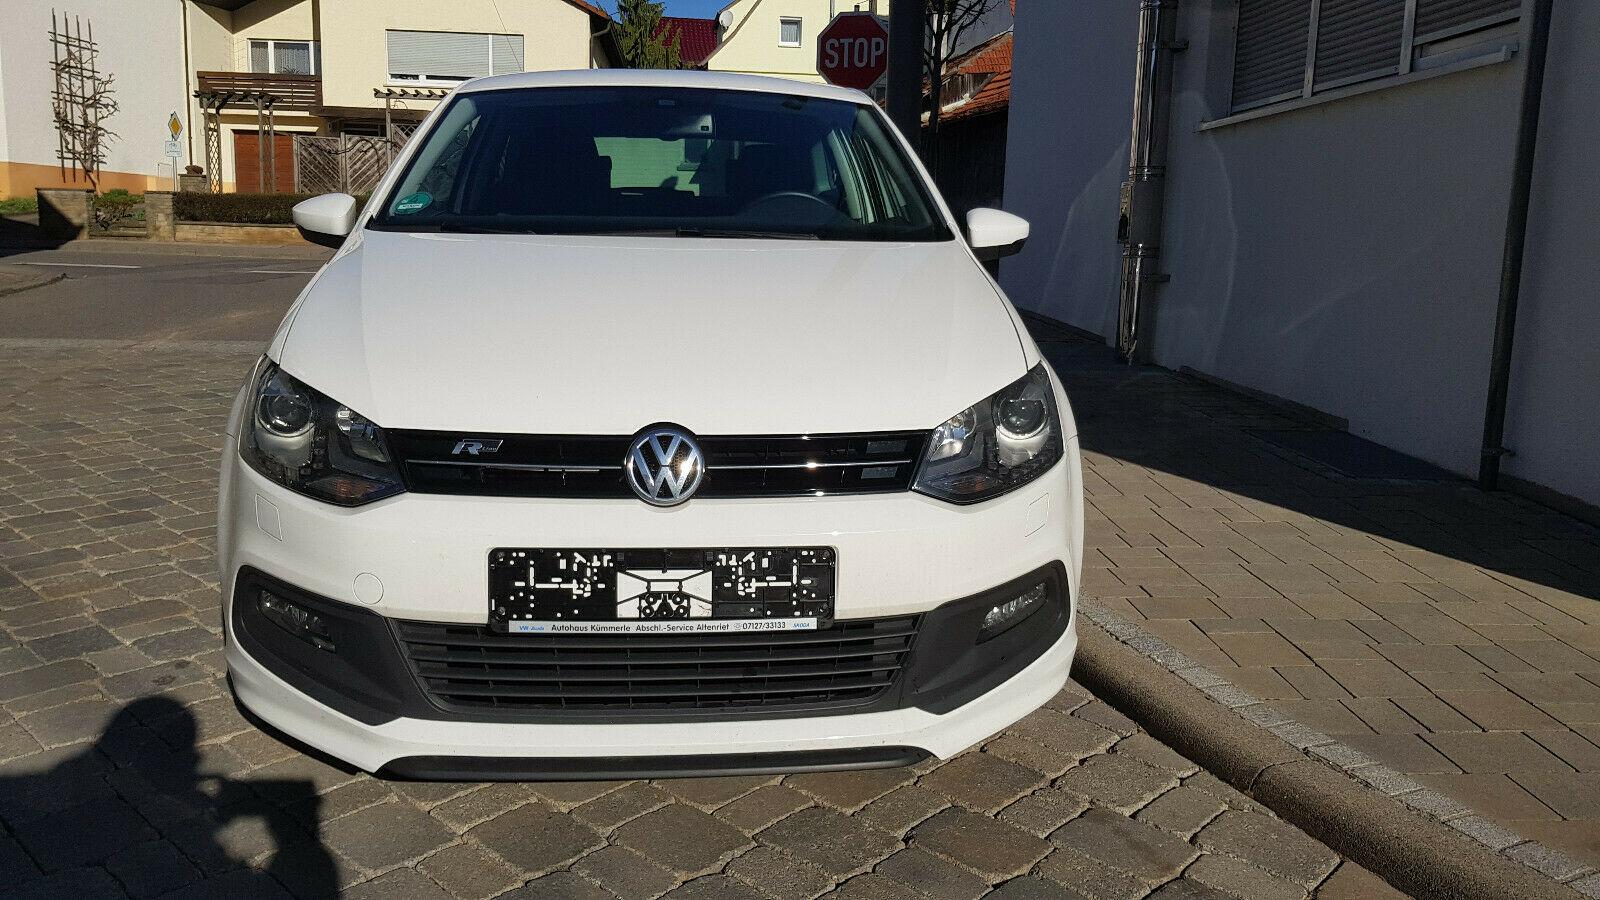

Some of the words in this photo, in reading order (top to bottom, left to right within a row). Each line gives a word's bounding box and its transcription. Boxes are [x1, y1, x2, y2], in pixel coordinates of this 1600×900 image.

[825, 37, 885, 69] STOP
[451, 441, 483, 456] R
[551, 624, 588, 632] Autohaus
[590, 624, 631, 632] Kümmerle
[696, 623, 730, 631] Altenriet
[742, 621, 786, 630] 07127/33133
